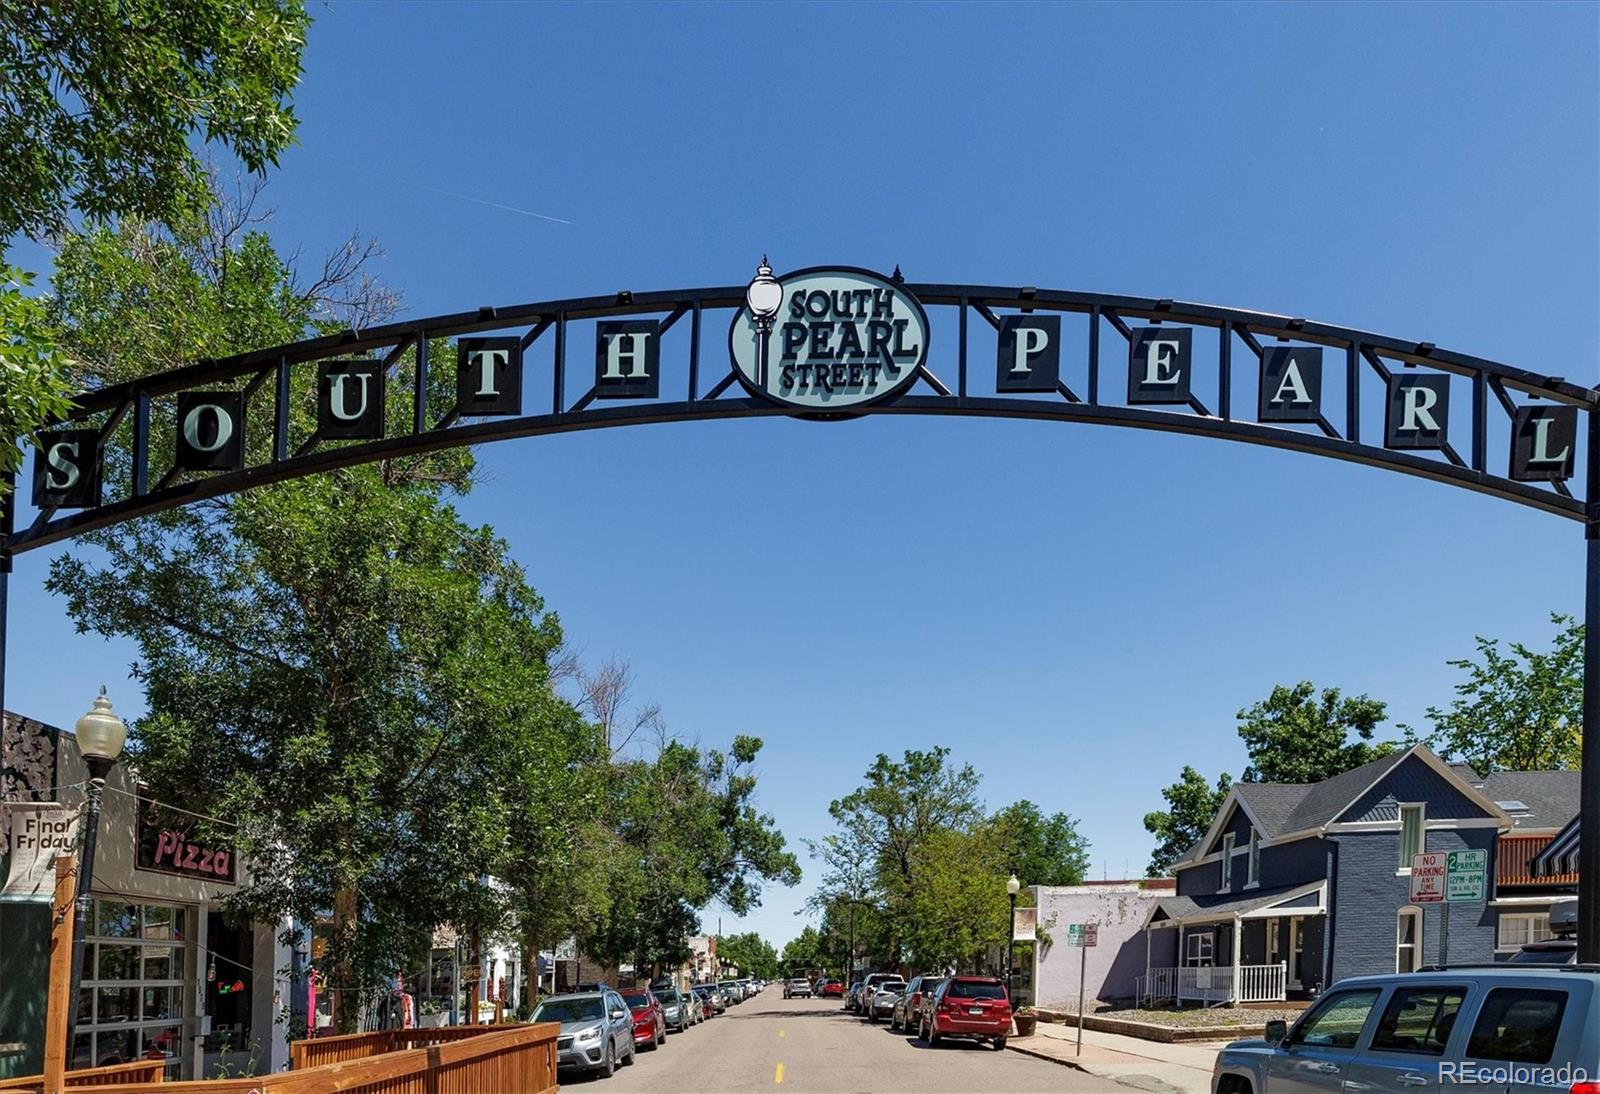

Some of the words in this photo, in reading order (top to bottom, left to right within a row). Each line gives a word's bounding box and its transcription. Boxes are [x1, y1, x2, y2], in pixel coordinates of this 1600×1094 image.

[791, 288, 895, 319] SOUTH
[782, 319, 918, 374] PEARL
[782, 363, 882, 393] STREET
[26, 819, 71, 833] Final
[16, 835, 76, 852] Friday
[154, 832, 230, 876] Pizza
[1422, 856, 1436, 865] NO
[1449, 855, 1456, 869] 2
[1413, 867, 1444, 877] PARKING
[1420, 883, 1435, 891] TIME
